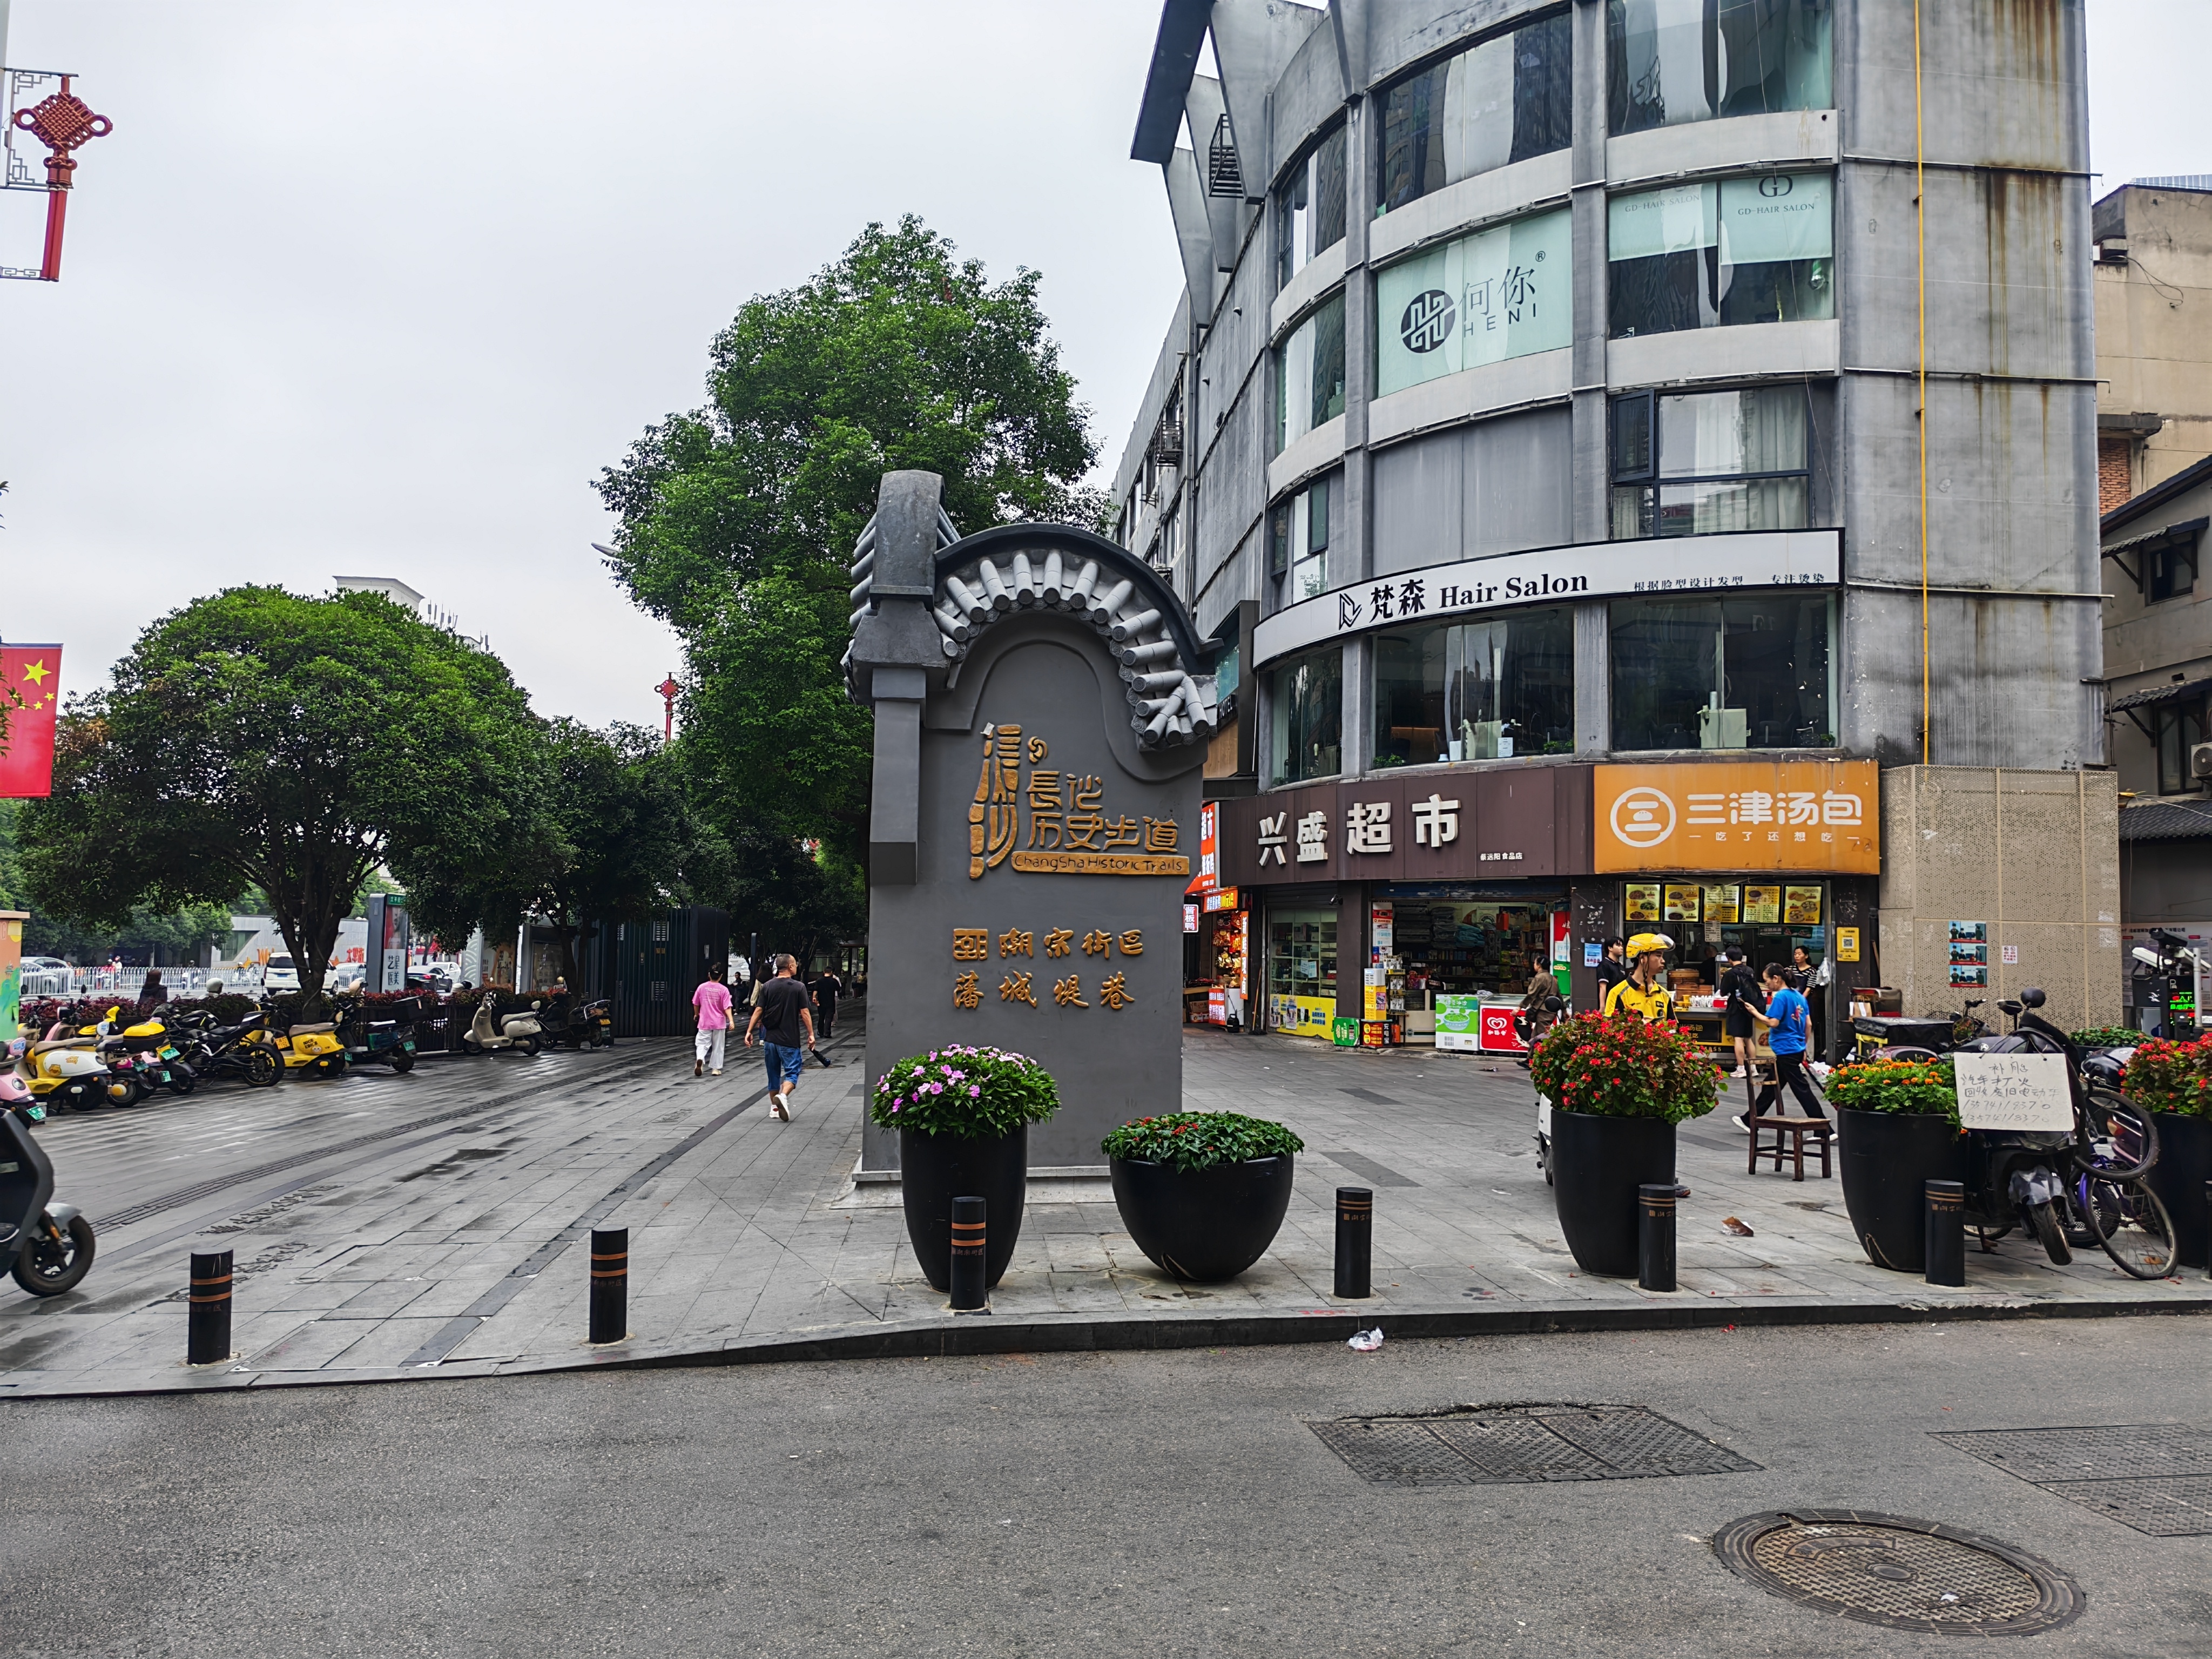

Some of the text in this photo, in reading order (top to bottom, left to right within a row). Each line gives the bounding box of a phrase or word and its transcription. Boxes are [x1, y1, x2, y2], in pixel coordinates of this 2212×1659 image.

[1625, 194, 1700, 212] GD-HAIR SALON
[1738, 203, 1815, 215] GD-HAIR SALON
[1458, 266, 1535, 322] 何你
[1464, 303, 1536, 338] HENI
[1634, 573, 1824, 591] 根据脸型设计发型 专注烫染
[1370, 574, 1589, 623] 梵森 Hair Salon
[1219, 695, 1233, 720] HOTEL
[1687, 790, 1862, 825] 三津汤包
[1258, 793, 1461, 866] 兴盛超市
[1088, 856, 1140, 871] Historic
[1142, 859, 1182, 872] Trails
[1184, 906, 1196, 931] 酱板鸭
